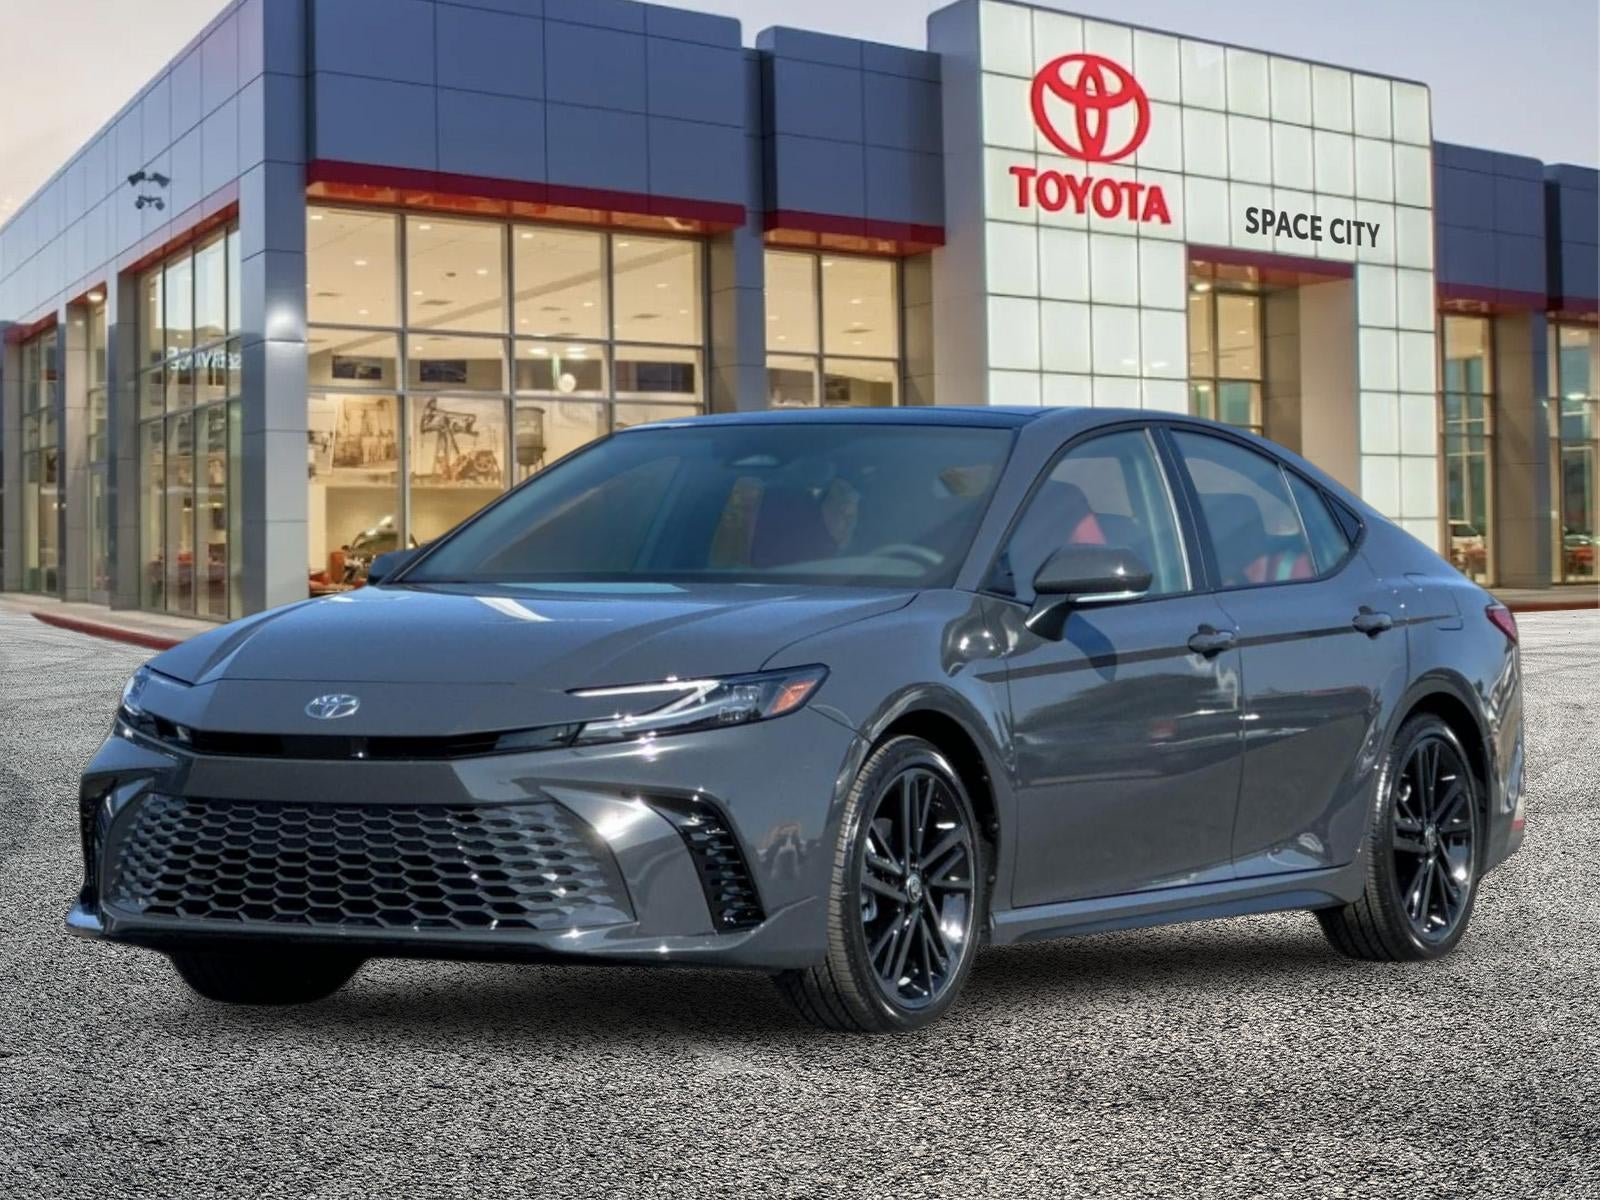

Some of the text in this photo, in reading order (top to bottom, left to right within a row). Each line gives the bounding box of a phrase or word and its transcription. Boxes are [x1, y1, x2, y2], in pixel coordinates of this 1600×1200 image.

[1009, 166, 1171, 225] TOYOTA
[1245, 206, 1381, 247] SPACE CITY
